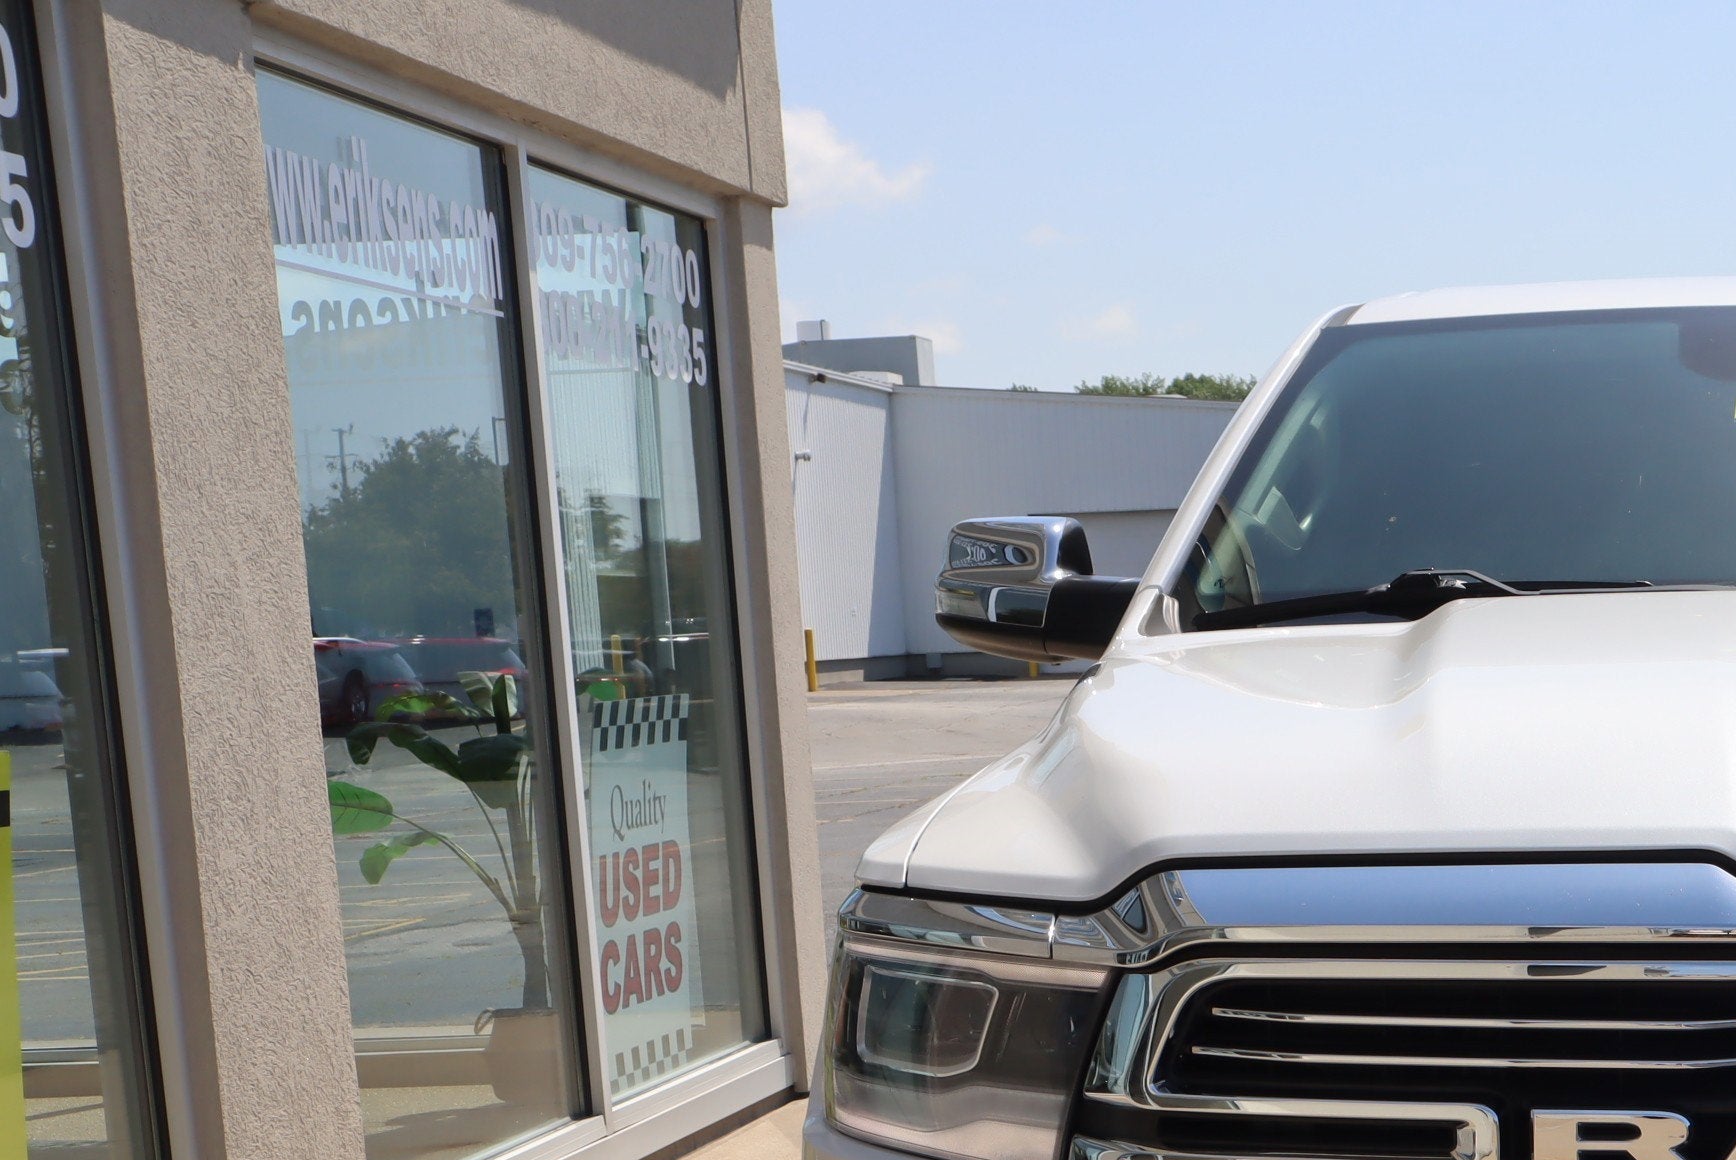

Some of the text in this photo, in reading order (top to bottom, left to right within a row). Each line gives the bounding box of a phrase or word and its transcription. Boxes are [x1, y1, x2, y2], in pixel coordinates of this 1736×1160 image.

[264, 135, 503, 302] ww.eriksens.com
[610, 778, 667, 842] Quality
[599, 838, 682, 928] USED
[600, 920, 683, 1016] CARS
